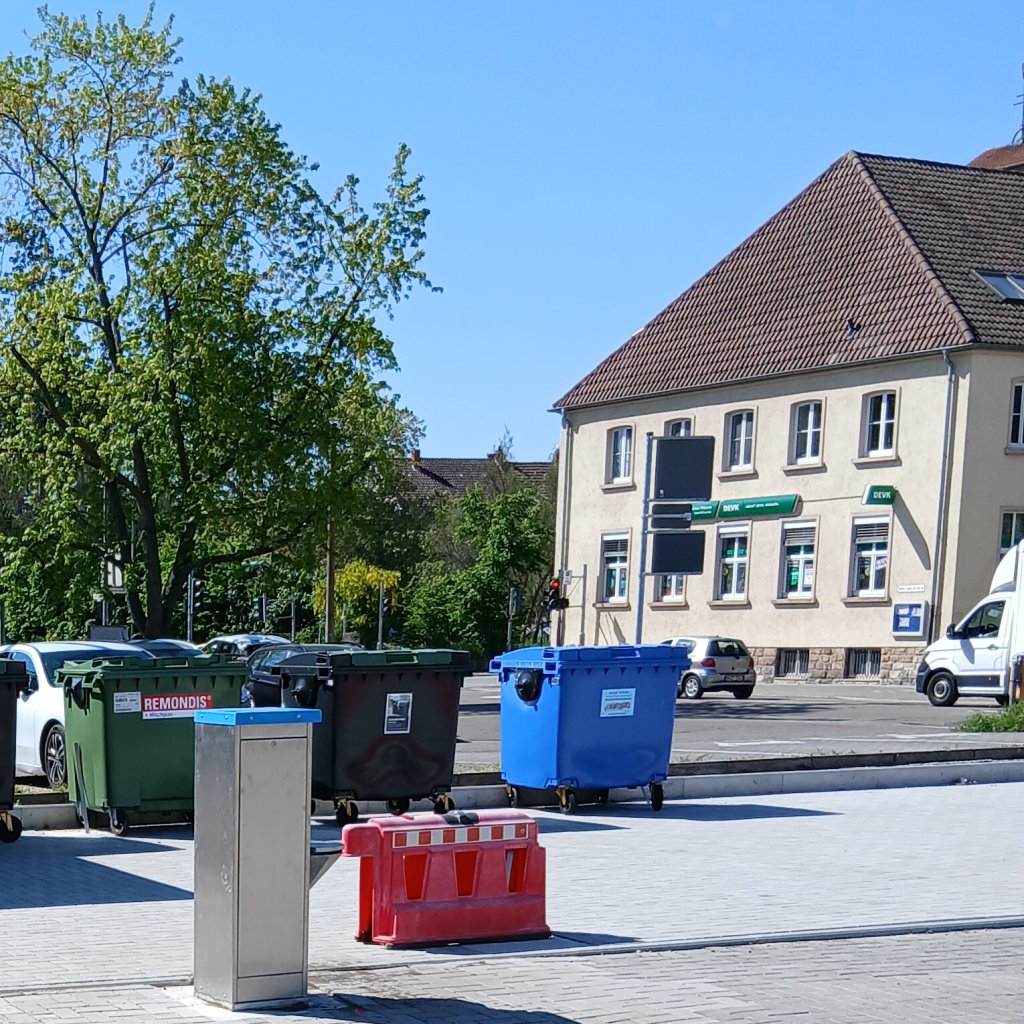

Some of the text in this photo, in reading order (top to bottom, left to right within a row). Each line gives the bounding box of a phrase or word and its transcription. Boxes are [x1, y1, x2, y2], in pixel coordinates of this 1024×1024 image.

[873, 491, 891, 499] DEVK
[723, 503, 740, 512] DEVK
[144, 695, 207, 711] REMONDIS
